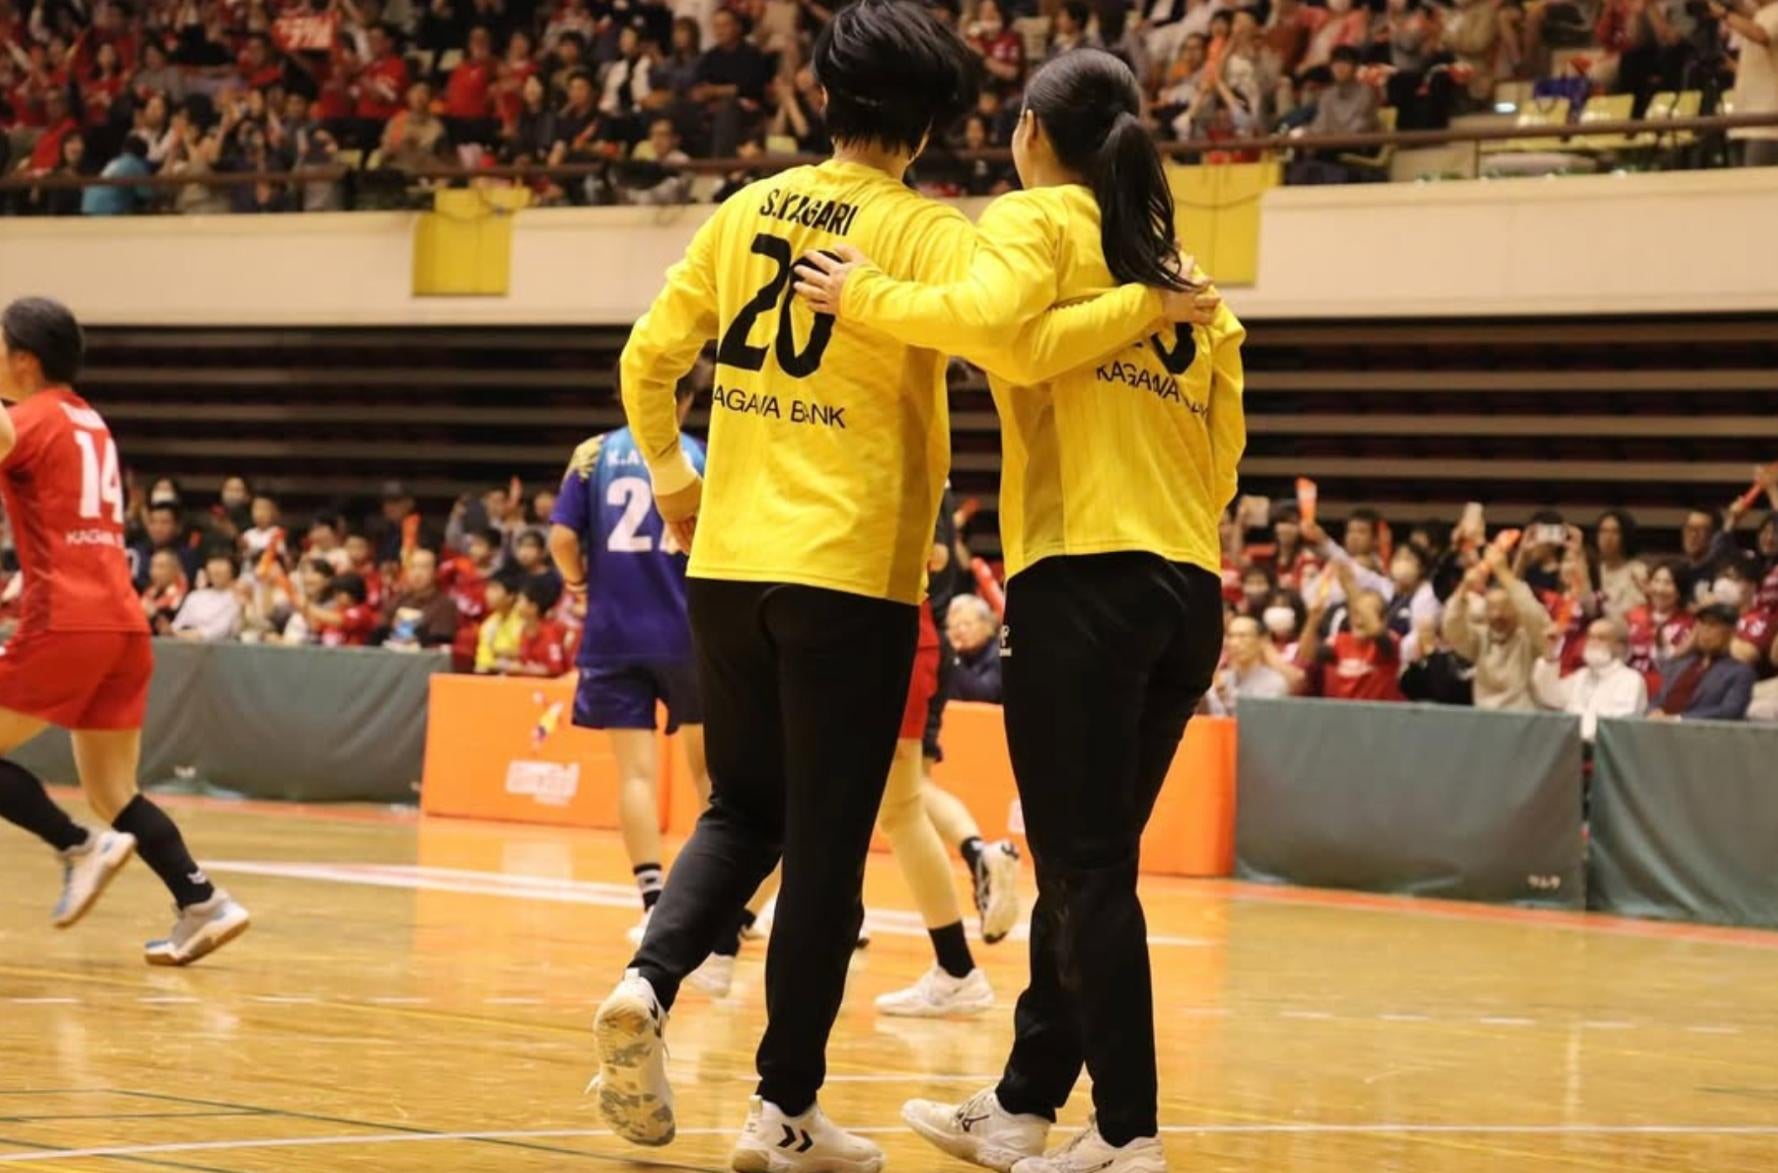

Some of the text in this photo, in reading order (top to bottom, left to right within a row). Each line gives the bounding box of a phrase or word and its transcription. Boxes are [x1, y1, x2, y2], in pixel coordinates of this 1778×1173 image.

[716, 232, 845, 379] 20
[714, 383, 846, 430] AGAA BNK
[74, 429, 124, 524] 14
[606, 475, 680, 553] 2
